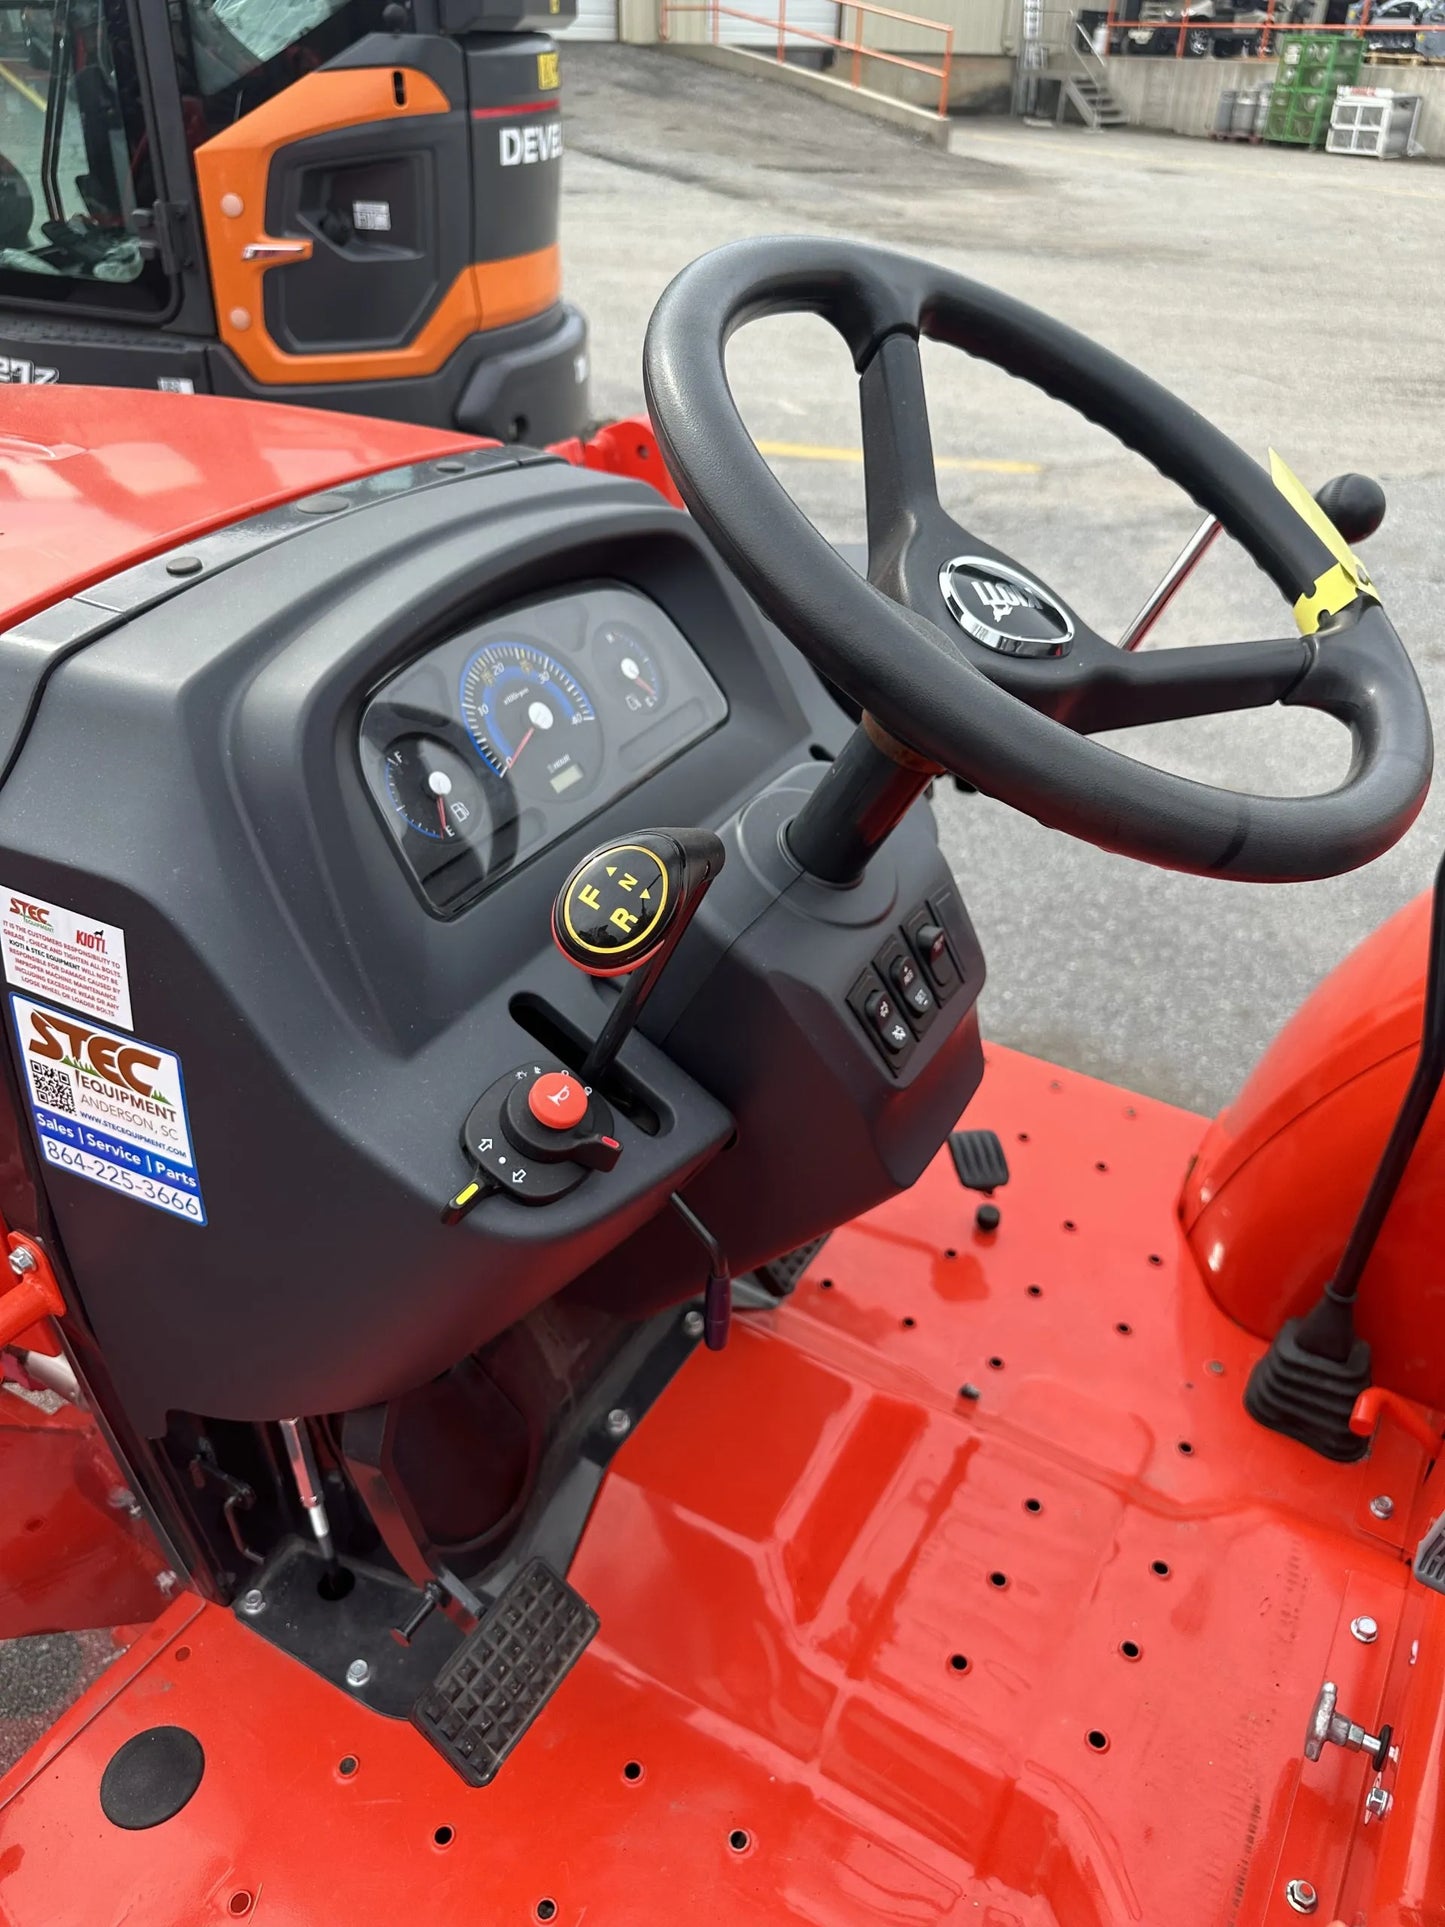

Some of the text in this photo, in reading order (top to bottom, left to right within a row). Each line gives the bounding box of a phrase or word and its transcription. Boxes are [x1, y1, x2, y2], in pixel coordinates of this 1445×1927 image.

[492, 662, 505, 676] 20
[477, 703, 489, 717] 10
[394, 751, 403, 763] F
[445, 824, 455, 837] E
[578, 884, 600, 910] F
[618, 872, 638, 892] N
[10, 897, 50, 925] STEC
[610, 907, 638, 933] R
[3, 928, 24, 941] GREASE
[28, 938, 48, 950] CHECK
[49, 946, 62, 955] AND
[63, 951, 88, 965] TIGHTEN
[89, 961, 100, 969] ALL
[15, 924, 26, 933] THE
[27, 929, 62, 947] CUSTOMERS
[63, 942, 110, 964] RESPONSIBILITY
[111, 960, 120, 968] TO
[76, 929, 106, 954] KIOTI
[9, 939, 24, 950] KIOTI
[30, 947, 45, 958] STEC
[45, 953, 80, 971] EQUIPMENT
[81, 966, 95, 977] WILL
[96, 972, 109, 982] NOT
[110, 977, 118, 985] BE
[9, 947, 120, 994] RESPONSIBLE FOR DAMAGE CAUSED BY
[14, 957, 116, 1001] IMPROPER MACHINE MAINTENANCE
[14, 965, 119, 1011] INCLUDING EXCESSIVE WEAR OR ANY
[21, 976, 40, 988] LOOSE
[41, 984, 60, 996] WHEEL
[61, 991, 70, 1000] OR
[71, 995, 95, 1009] LOADER
[29, 1009, 161, 1097] STEC
[81, 1075, 177, 1122] EQUIPMENT
[36, 1112, 74, 1139] Sales
[85, 1132, 142, 1166] Service
[154, 1160, 197, 1188] Parts
[80, 1112, 186, 1158] WWW.STECEQUIPMENT.COM
[160, 1124, 179, 1143] SC
[45, 1139, 198, 1216] 864-225-3666
